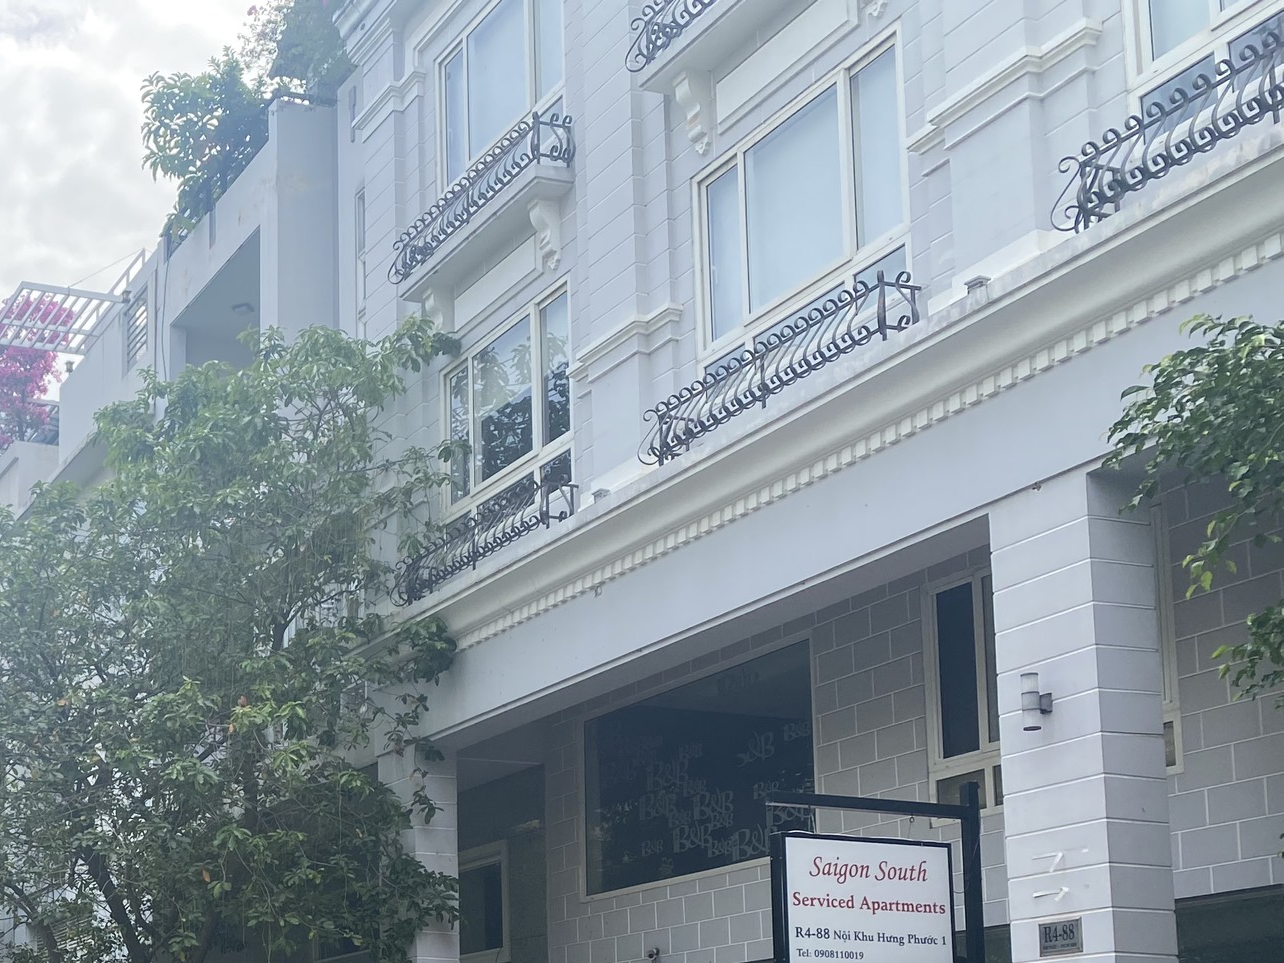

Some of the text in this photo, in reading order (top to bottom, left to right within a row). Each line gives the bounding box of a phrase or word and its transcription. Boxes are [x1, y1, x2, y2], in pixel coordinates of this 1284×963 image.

[693, 787, 734, 820] B&B
[673, 821, 713, 854] B&B
[809, 856, 928, 884] Saigon South
[792, 891, 946, 915] Serviced Apartments
[795, 926, 831, 940] R4-88
[833, 930, 851, 943] Nội
[853, 930, 875, 942] Khu
[877, 932, 905, 946] Hưng
[941, 936, 947, 945] 1
[1043, 923, 1075, 943] R4-88
[796, 948, 864, 960] Tel: 0908110019
